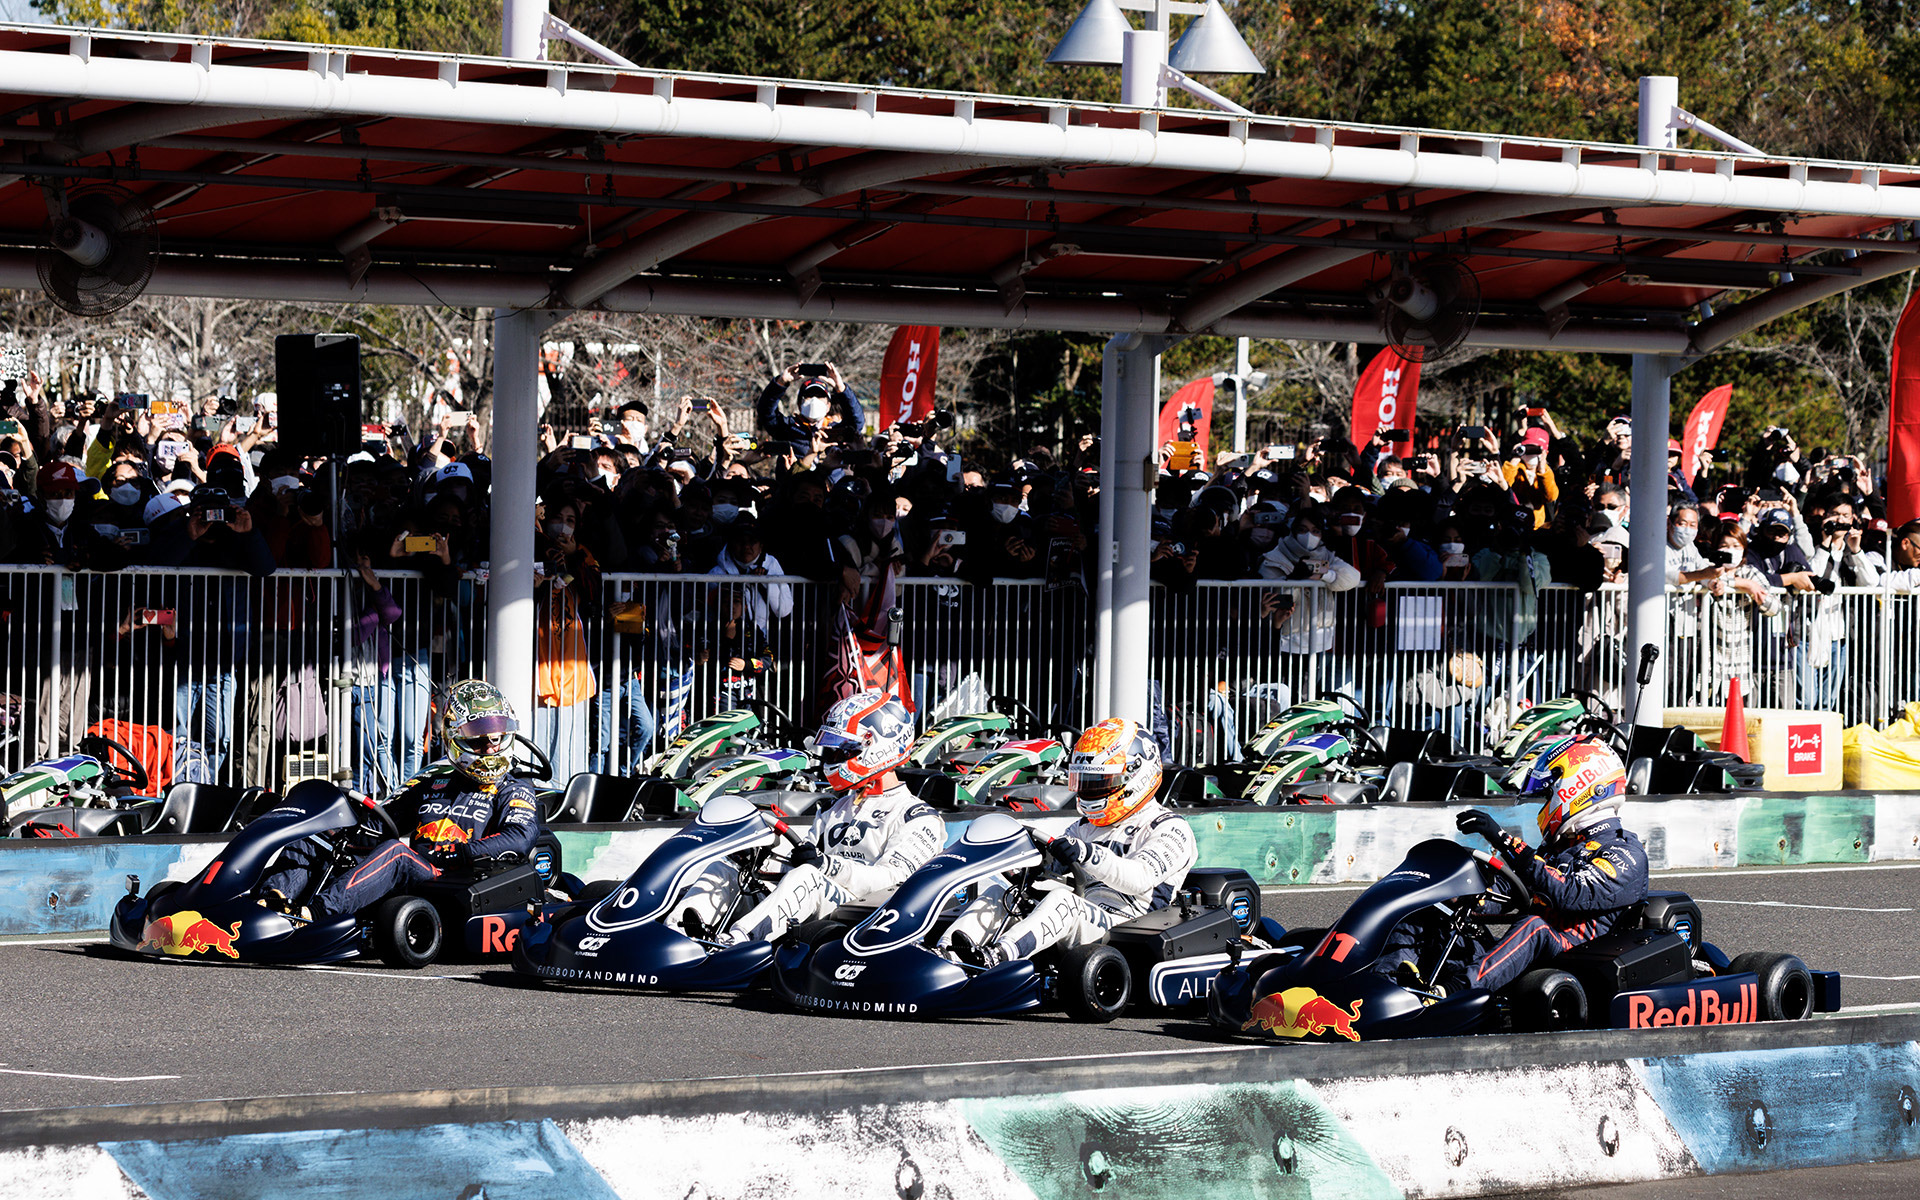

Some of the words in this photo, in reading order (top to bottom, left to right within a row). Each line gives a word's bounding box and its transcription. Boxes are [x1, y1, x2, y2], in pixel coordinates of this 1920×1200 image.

[1789, 733, 1821, 749] ブレーキ
[1793, 751, 1817, 762] BRAKE
[418, 803, 489, 823] ORACLE
[1587, 822, 1611, 836] zoom
[612, 887, 640, 909] 10
